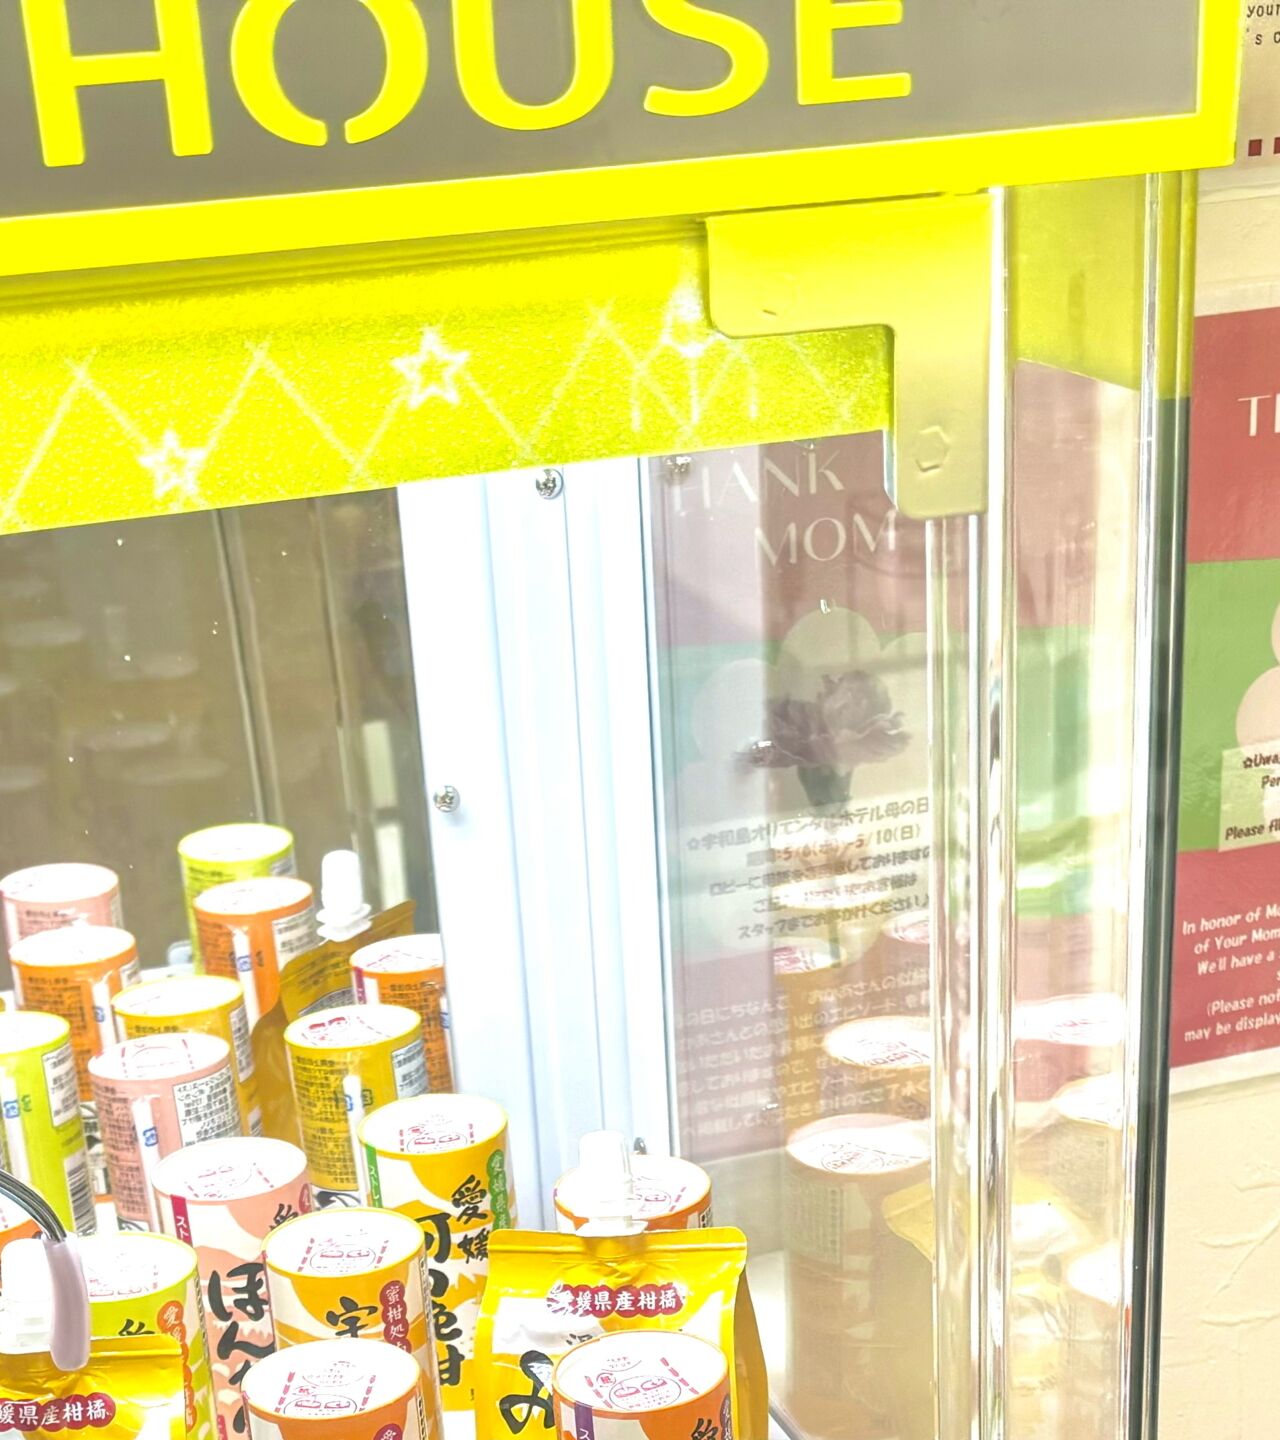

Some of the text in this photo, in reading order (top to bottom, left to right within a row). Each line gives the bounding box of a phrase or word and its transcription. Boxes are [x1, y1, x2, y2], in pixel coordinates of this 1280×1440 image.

[21, 0, 913, 168] HOUSE
[672, 449, 846, 513] HANK
[754, 508, 897, 567] MOM
[1225, 824, 1264, 840] Please
[1182, 920, 1195, 936] In
[1200, 914, 1241, 932] honor
[1245, 907, 1261, 922] of
[1194, 939, 1210, 954] of
[1214, 934, 1247, 949] Your
[1231, 952, 1262, 970] have
[1266, 951, 1275, 963] a
[1206, 997, 1254, 1017] (Please
[1184, 1027, 1211, 1043] may
[1215, 1021, 1231, 1036] be
